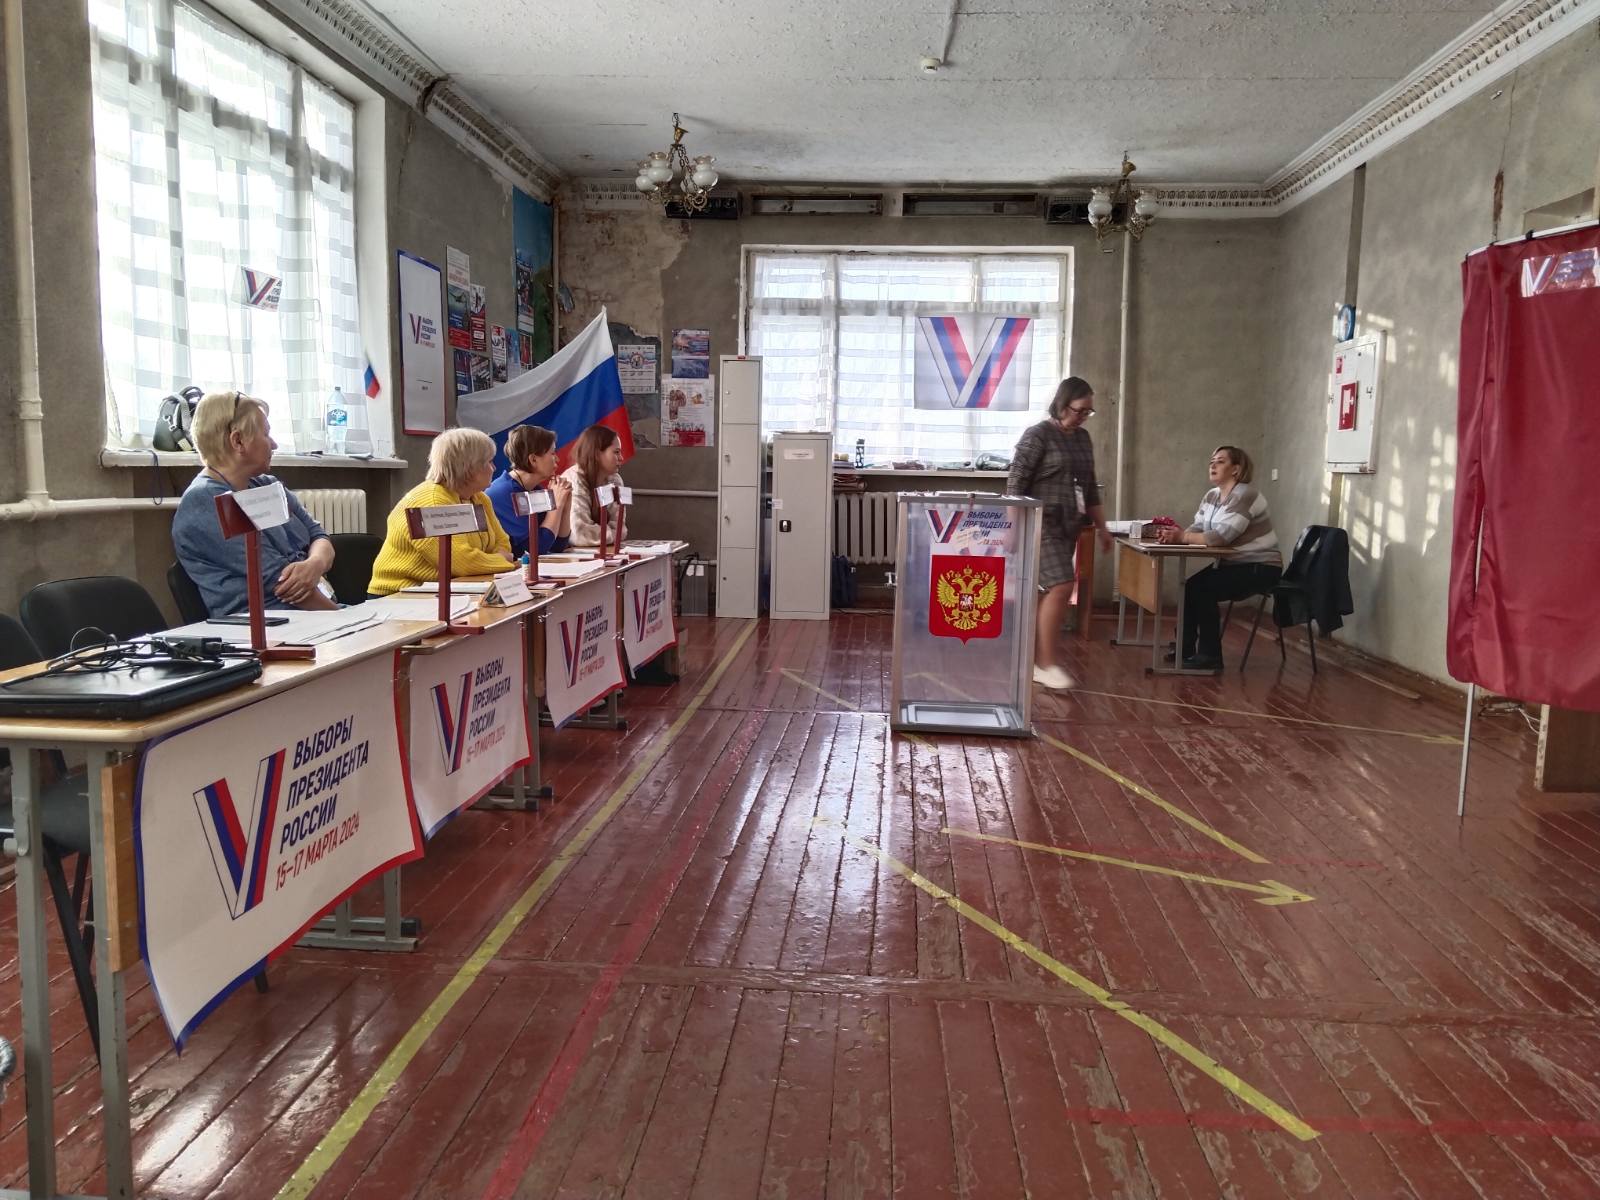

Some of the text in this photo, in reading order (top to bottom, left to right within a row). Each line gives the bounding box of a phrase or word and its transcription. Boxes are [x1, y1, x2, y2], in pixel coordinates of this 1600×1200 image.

[967, 511, 1003, 520] ВЫБОРЫ
[472, 676, 511, 713] ПРЕЗИДЕНТА
[475, 657, 504, 686] ВЫБОРЫ
[292, 715, 354, 770] ВЫБОРЫ
[468, 708, 496, 740] РОССИИ
[286, 740, 370, 812] ПРЕЗИДЕНТА
[279, 793, 338, 854] РОССИИ
[304, 833, 338, 871] МАРТА
[338, 811, 361, 846] 2024
